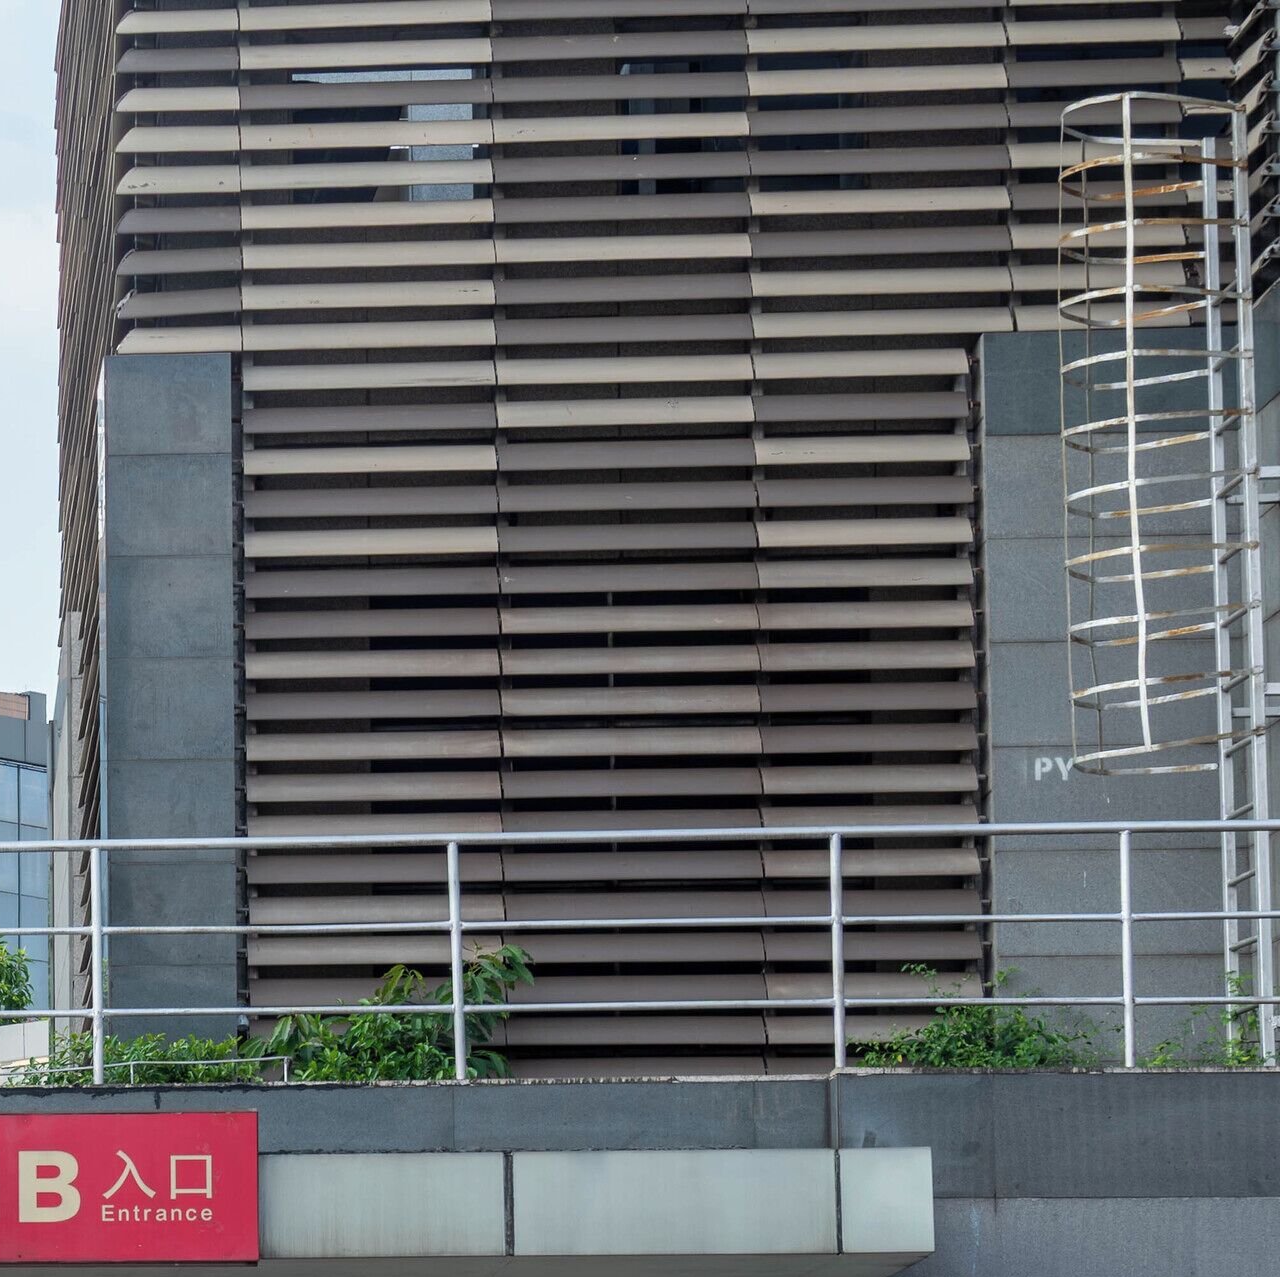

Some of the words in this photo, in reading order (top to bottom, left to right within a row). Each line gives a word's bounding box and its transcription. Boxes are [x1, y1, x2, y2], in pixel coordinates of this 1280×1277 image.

[18, 1150, 82, 1224] B
[102, 1150, 213, 1200] 入口
[101, 1204, 213, 1222] Entrance
